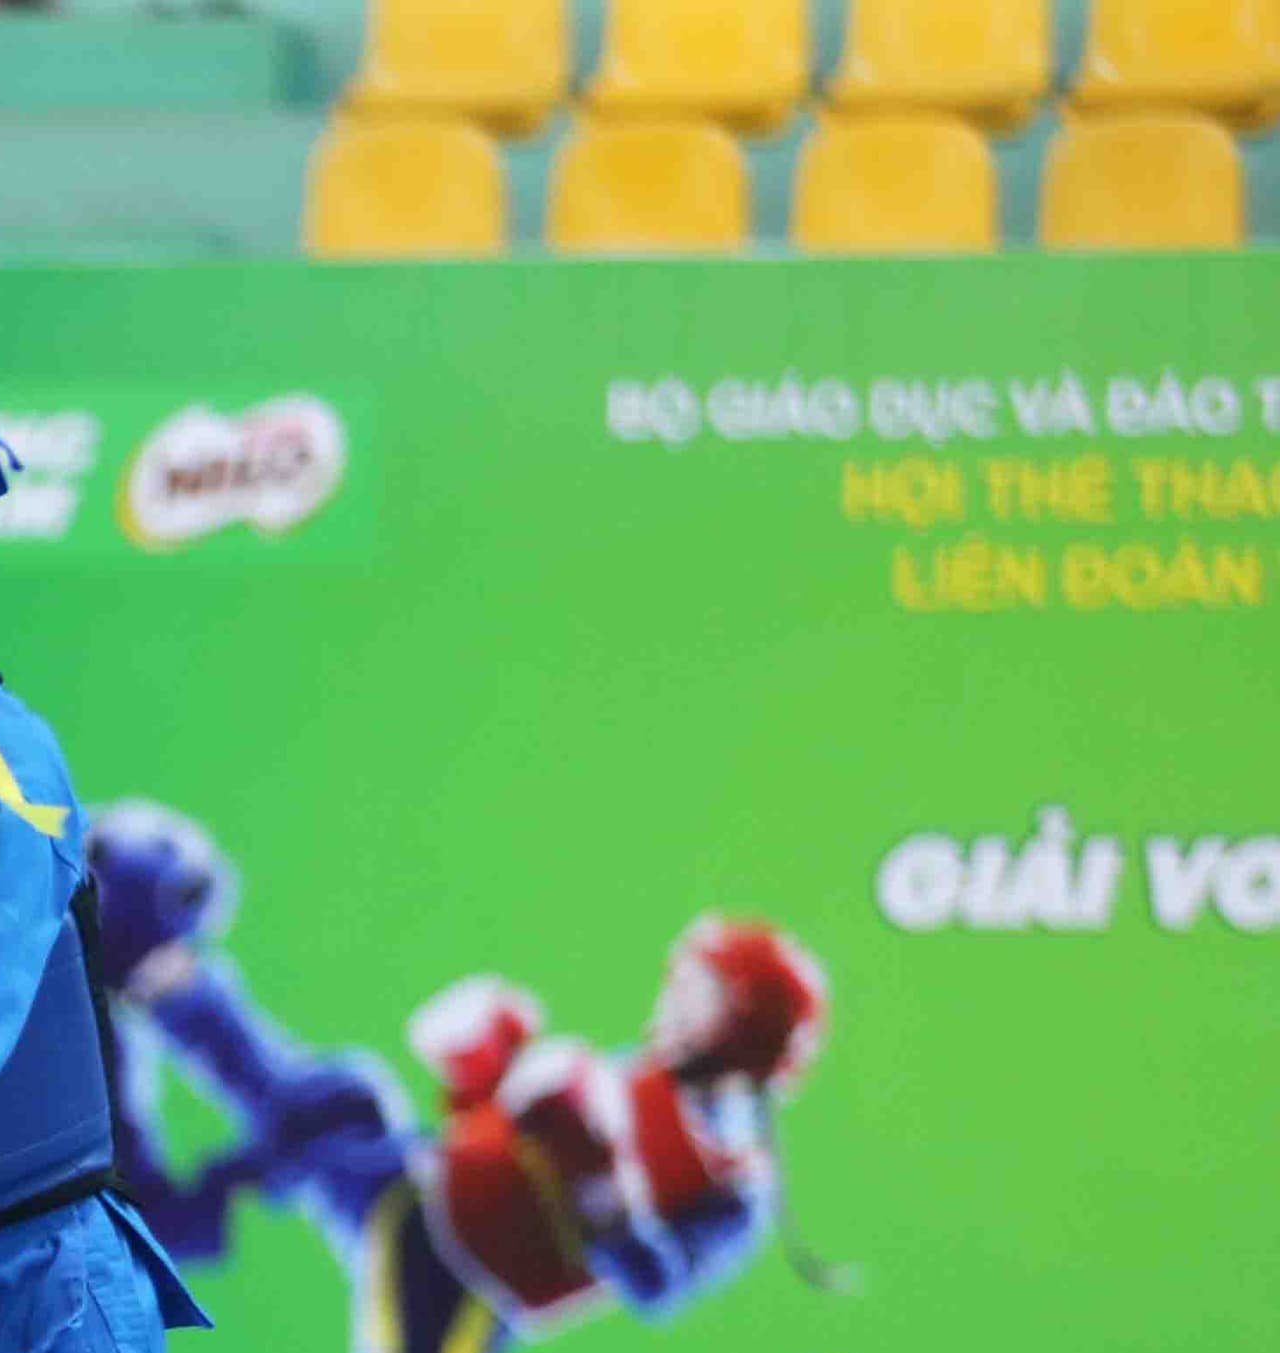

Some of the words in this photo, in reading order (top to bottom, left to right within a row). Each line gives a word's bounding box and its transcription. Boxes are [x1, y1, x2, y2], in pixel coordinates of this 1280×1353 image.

[707, 367, 860, 442] GIÁO
[1008, 366, 1095, 437] VÀ
[878, 804, 1124, 931] GIẢI
